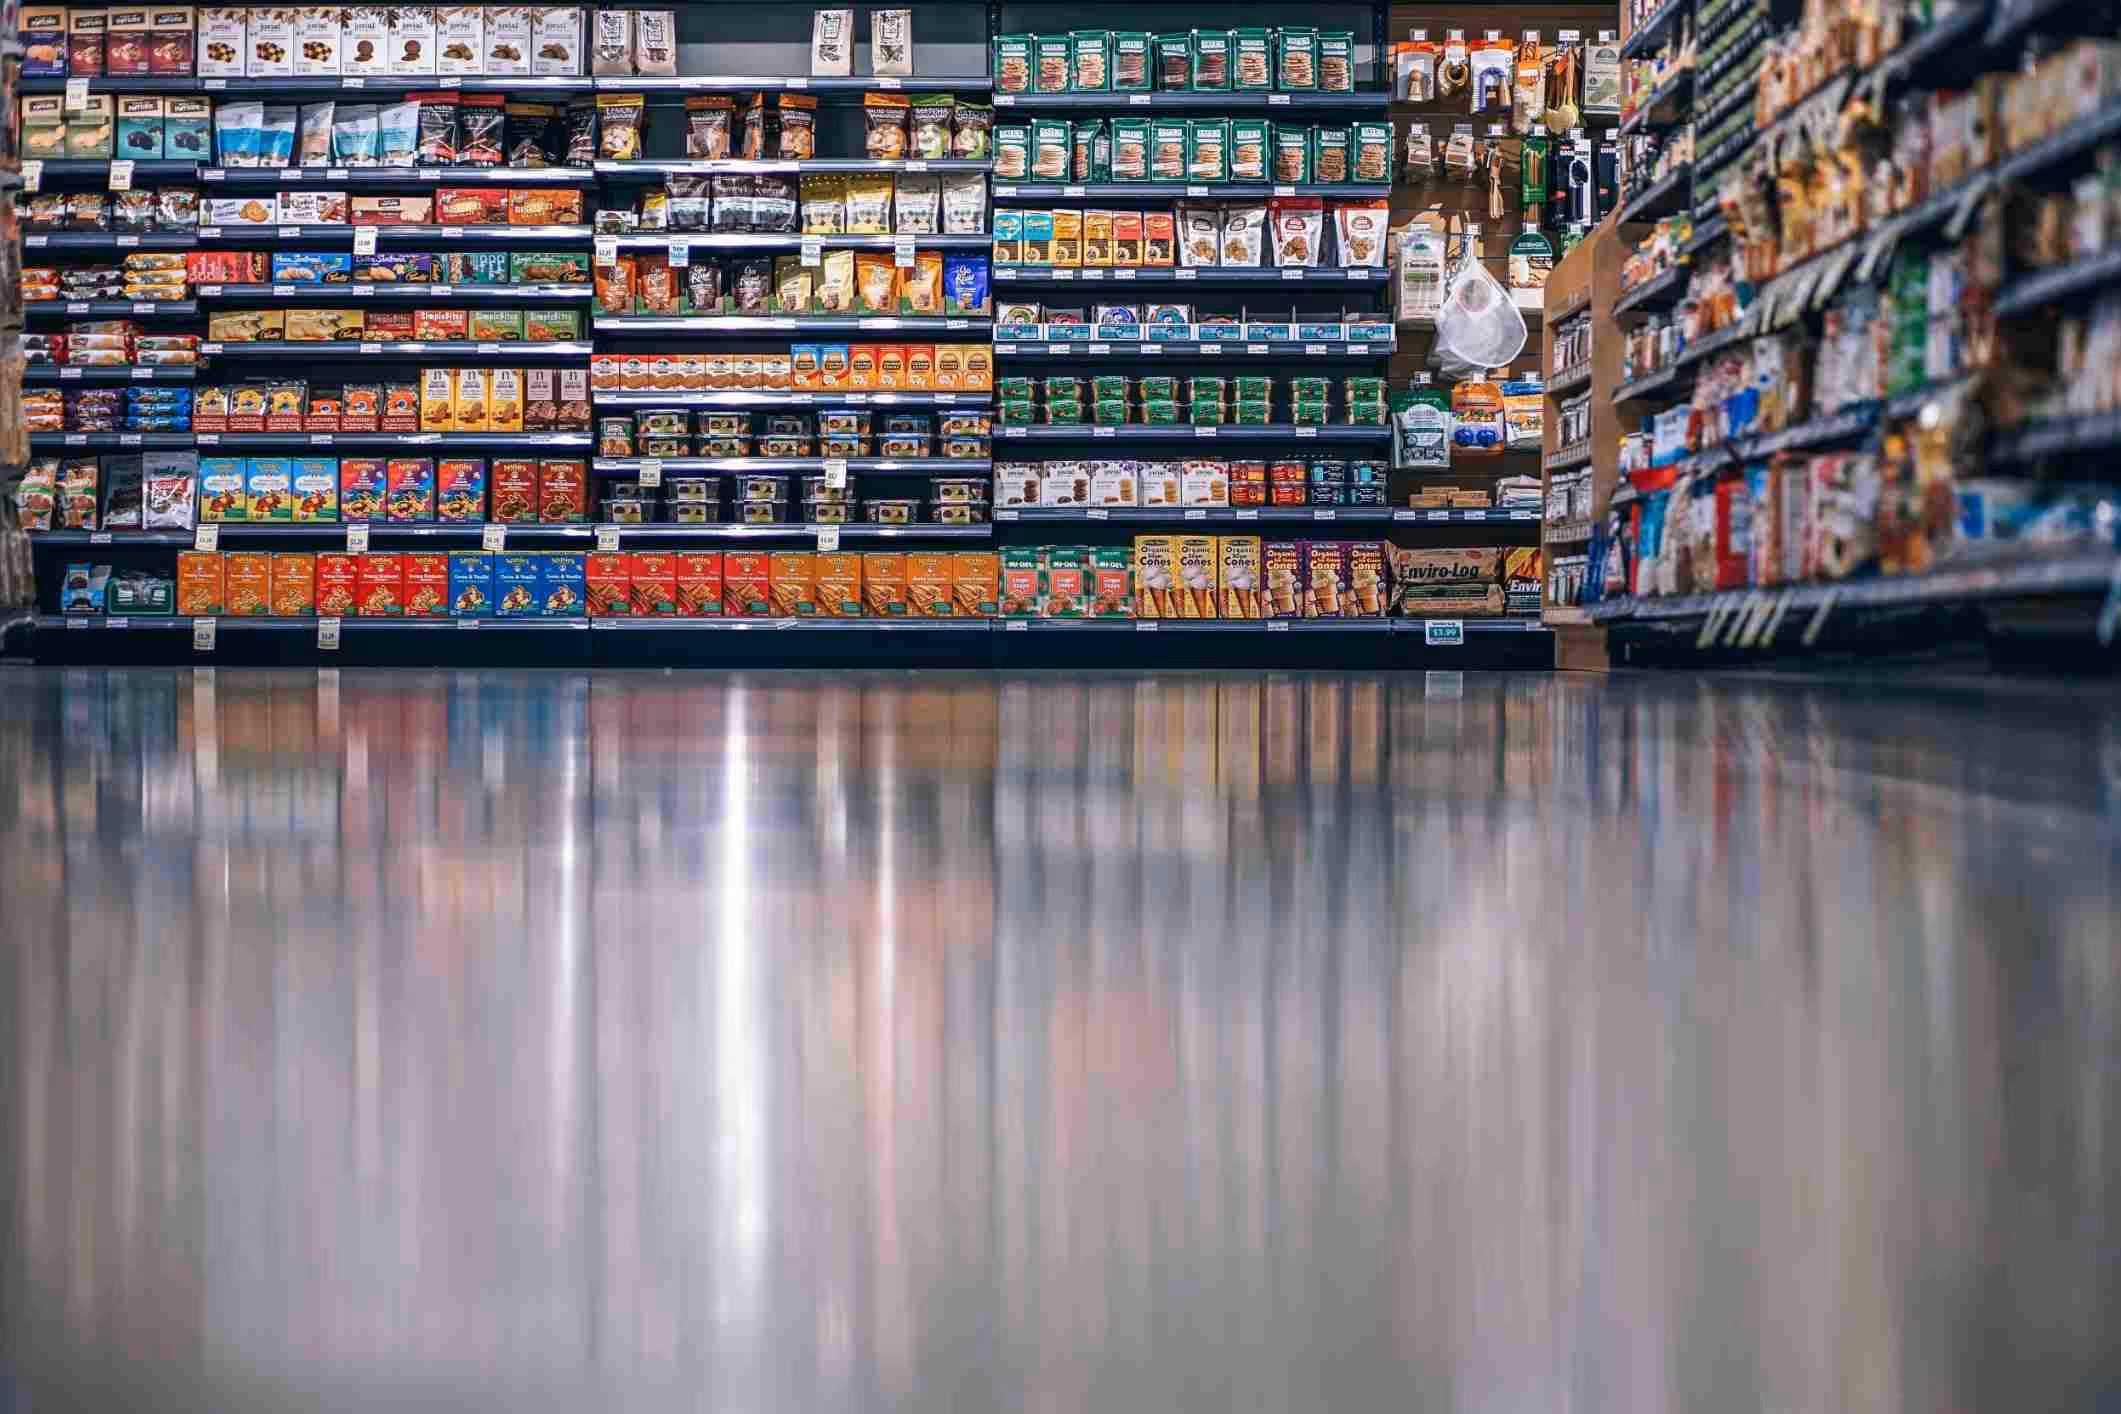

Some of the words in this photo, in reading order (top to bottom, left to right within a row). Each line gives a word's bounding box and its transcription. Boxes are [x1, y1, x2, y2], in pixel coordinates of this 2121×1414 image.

[1139, 556, 1171, 566] Cones
[1180, 556, 1212, 566] Cones
[1224, 556, 1256, 566] Cones
[1266, 561, 1297, 570] Cones
[1310, 561, 1341, 570] Cones
[1350, 561, 1381, 570] Cones
